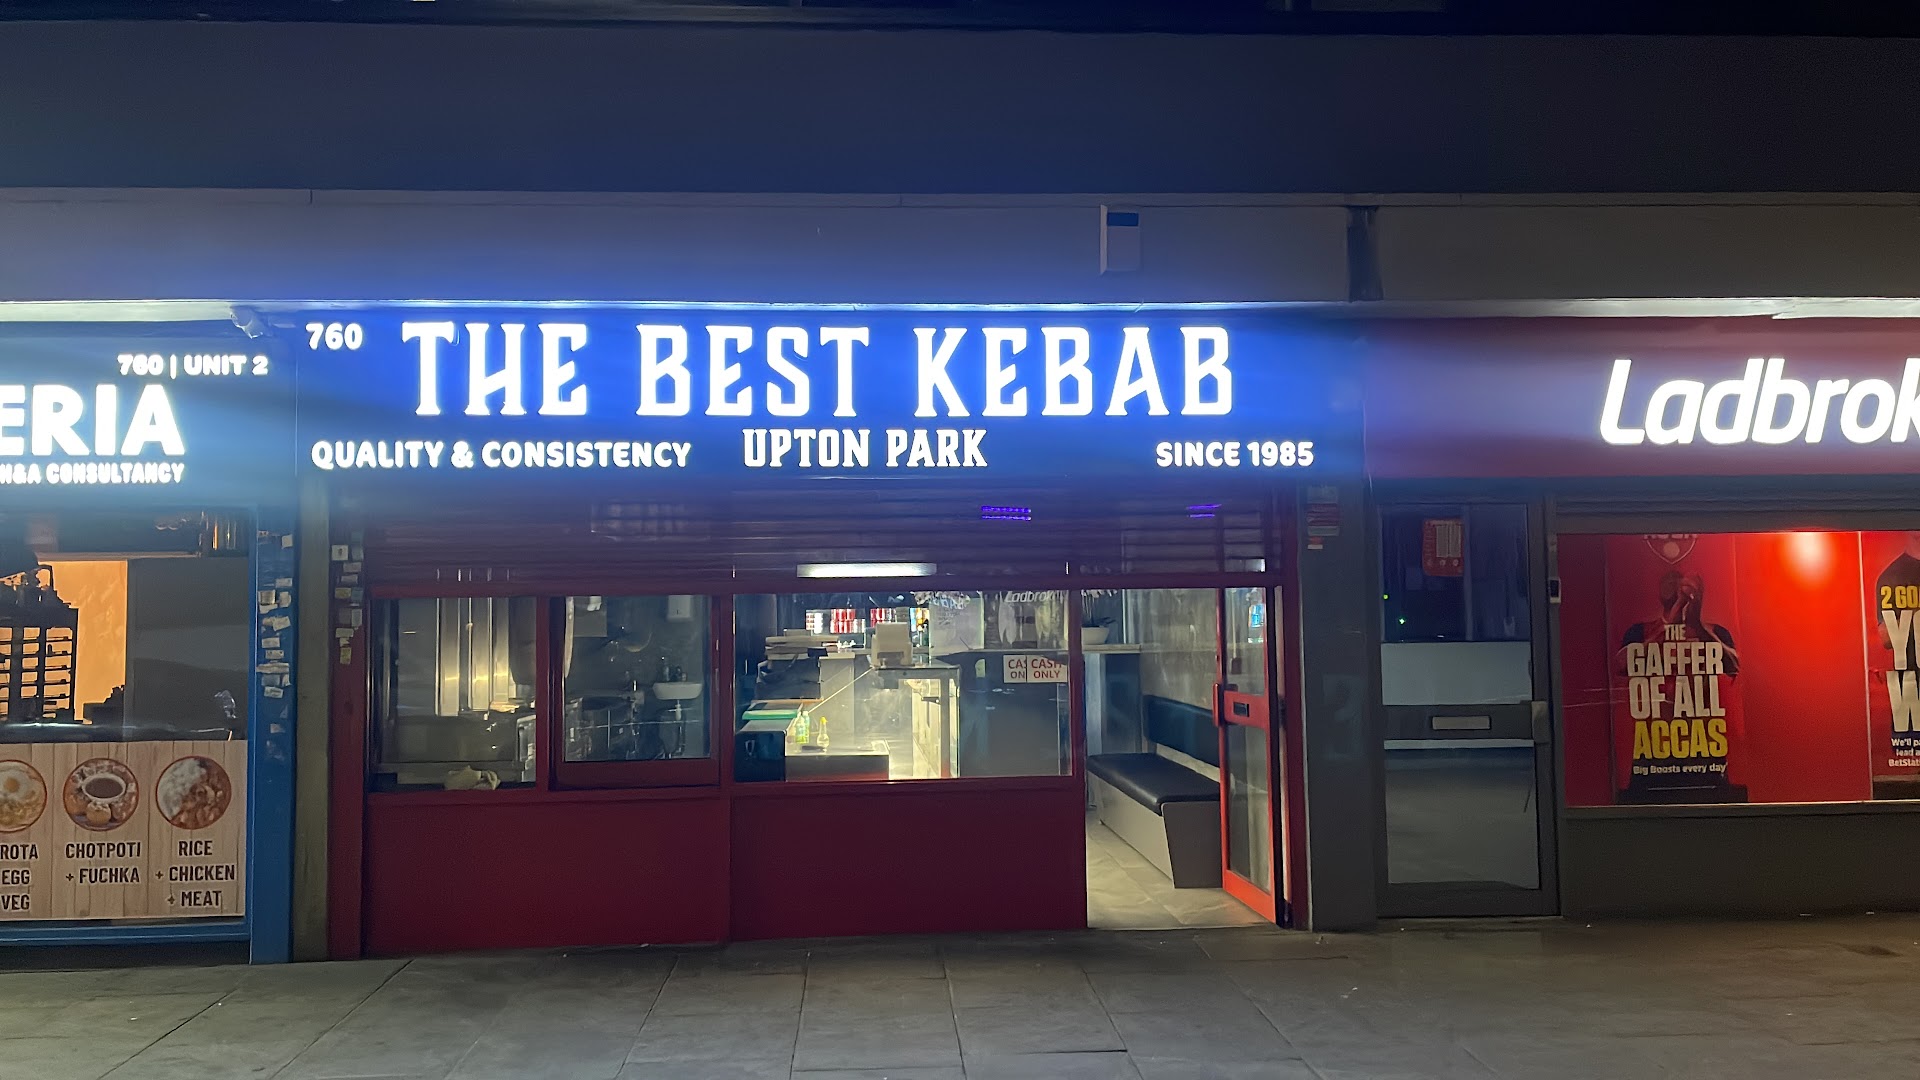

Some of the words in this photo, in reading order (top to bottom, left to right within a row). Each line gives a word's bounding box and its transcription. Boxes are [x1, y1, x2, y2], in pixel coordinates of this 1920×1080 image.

[306, 323, 362, 349] 760
[117, 354, 164, 376] 760
[183, 354, 248, 376] UNIT
[252, 355, 268, 375] 2
[402, 321, 587, 416] THE
[635, 323, 869, 417] BEST
[913, 326, 1232, 417] KEBAB
[0, 384, 186, 456] ERIA
[311, 440, 444, 470] QUALITY
[451, 440, 474, 468] &
[481, 441, 691, 468] CONSISTENCY
[743, 428, 871, 468] UPTON
[886, 429, 988, 467] PARK
[1156, 441, 1241, 467] SINCE
[1246, 440, 1314, 467] 1985
[46, 462, 185, 485] CONSULTANCY
[1880, 586, 1893, 609] 2
[1895, 585, 1920, 609] GO
[1664, 623, 1686, 641] THE
[1627, 641, 1724, 677] GAFFER
[1033, 670, 1060, 679] ONLY
[1628, 676, 1666, 720] OF
[1673, 674, 1726, 718] ALL
[1633, 718, 1729, 760] ACCAS
[1633, 765, 1649, 775] Big
[1682, 763, 1708, 774] every
[0, 843, 39, 860] ROTA
[65, 841, 141, 859] CHOTPOTI
[178, 840, 213, 856] RICE
[2, 869, 30, 885] EGG
[79, 867, 140, 884] FUCHKA
[169, 864, 235, 882] CHICKEN
[1, 894, 30, 911] VEG
[181, 890, 222, 907] MEAT
